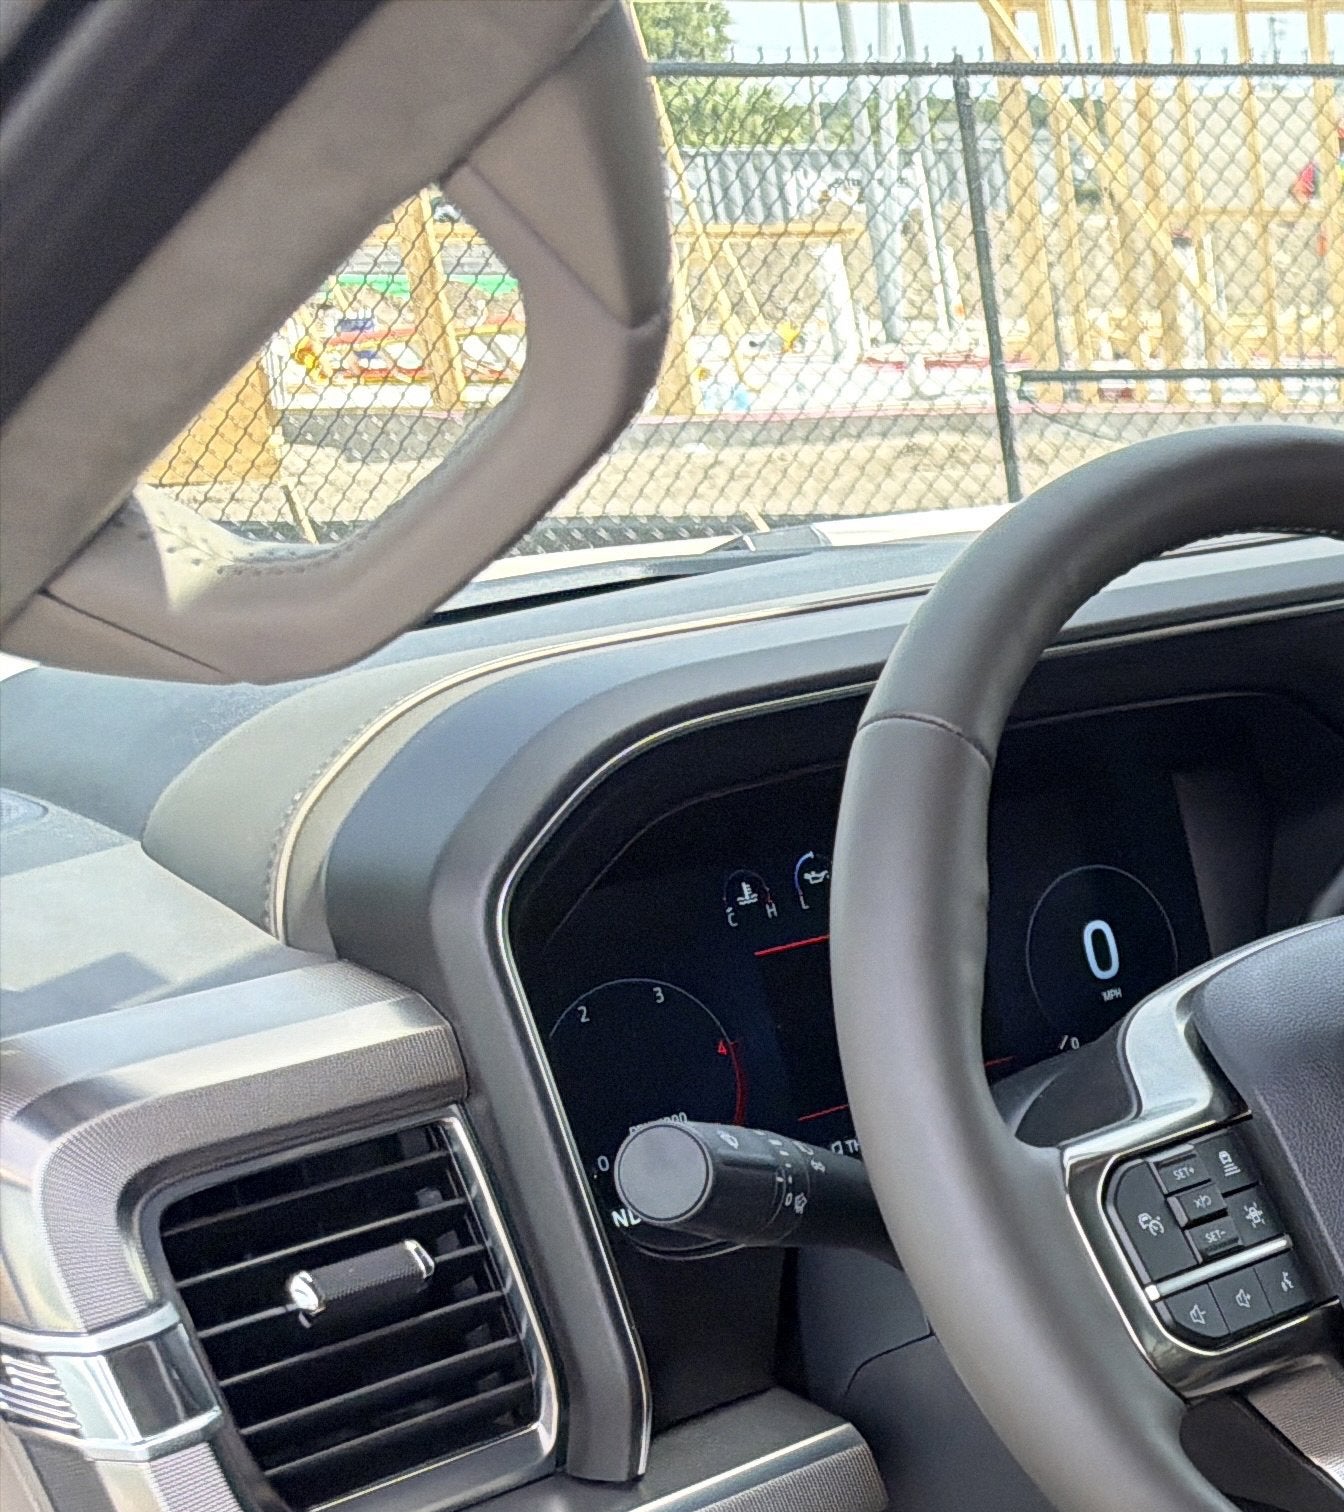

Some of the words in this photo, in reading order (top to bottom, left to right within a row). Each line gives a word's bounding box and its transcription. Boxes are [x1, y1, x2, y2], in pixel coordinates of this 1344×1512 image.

[765, 902, 778, 919] H
[1083, 919, 1120, 980] 0
[652, 986, 665, 1004] 3
[1101, 987, 1122, 1002] MPH
[577, 1005, 591, 1023] 2
[716, 1040, 727, 1056] 4
[597, 1155, 610, 1172] 0
